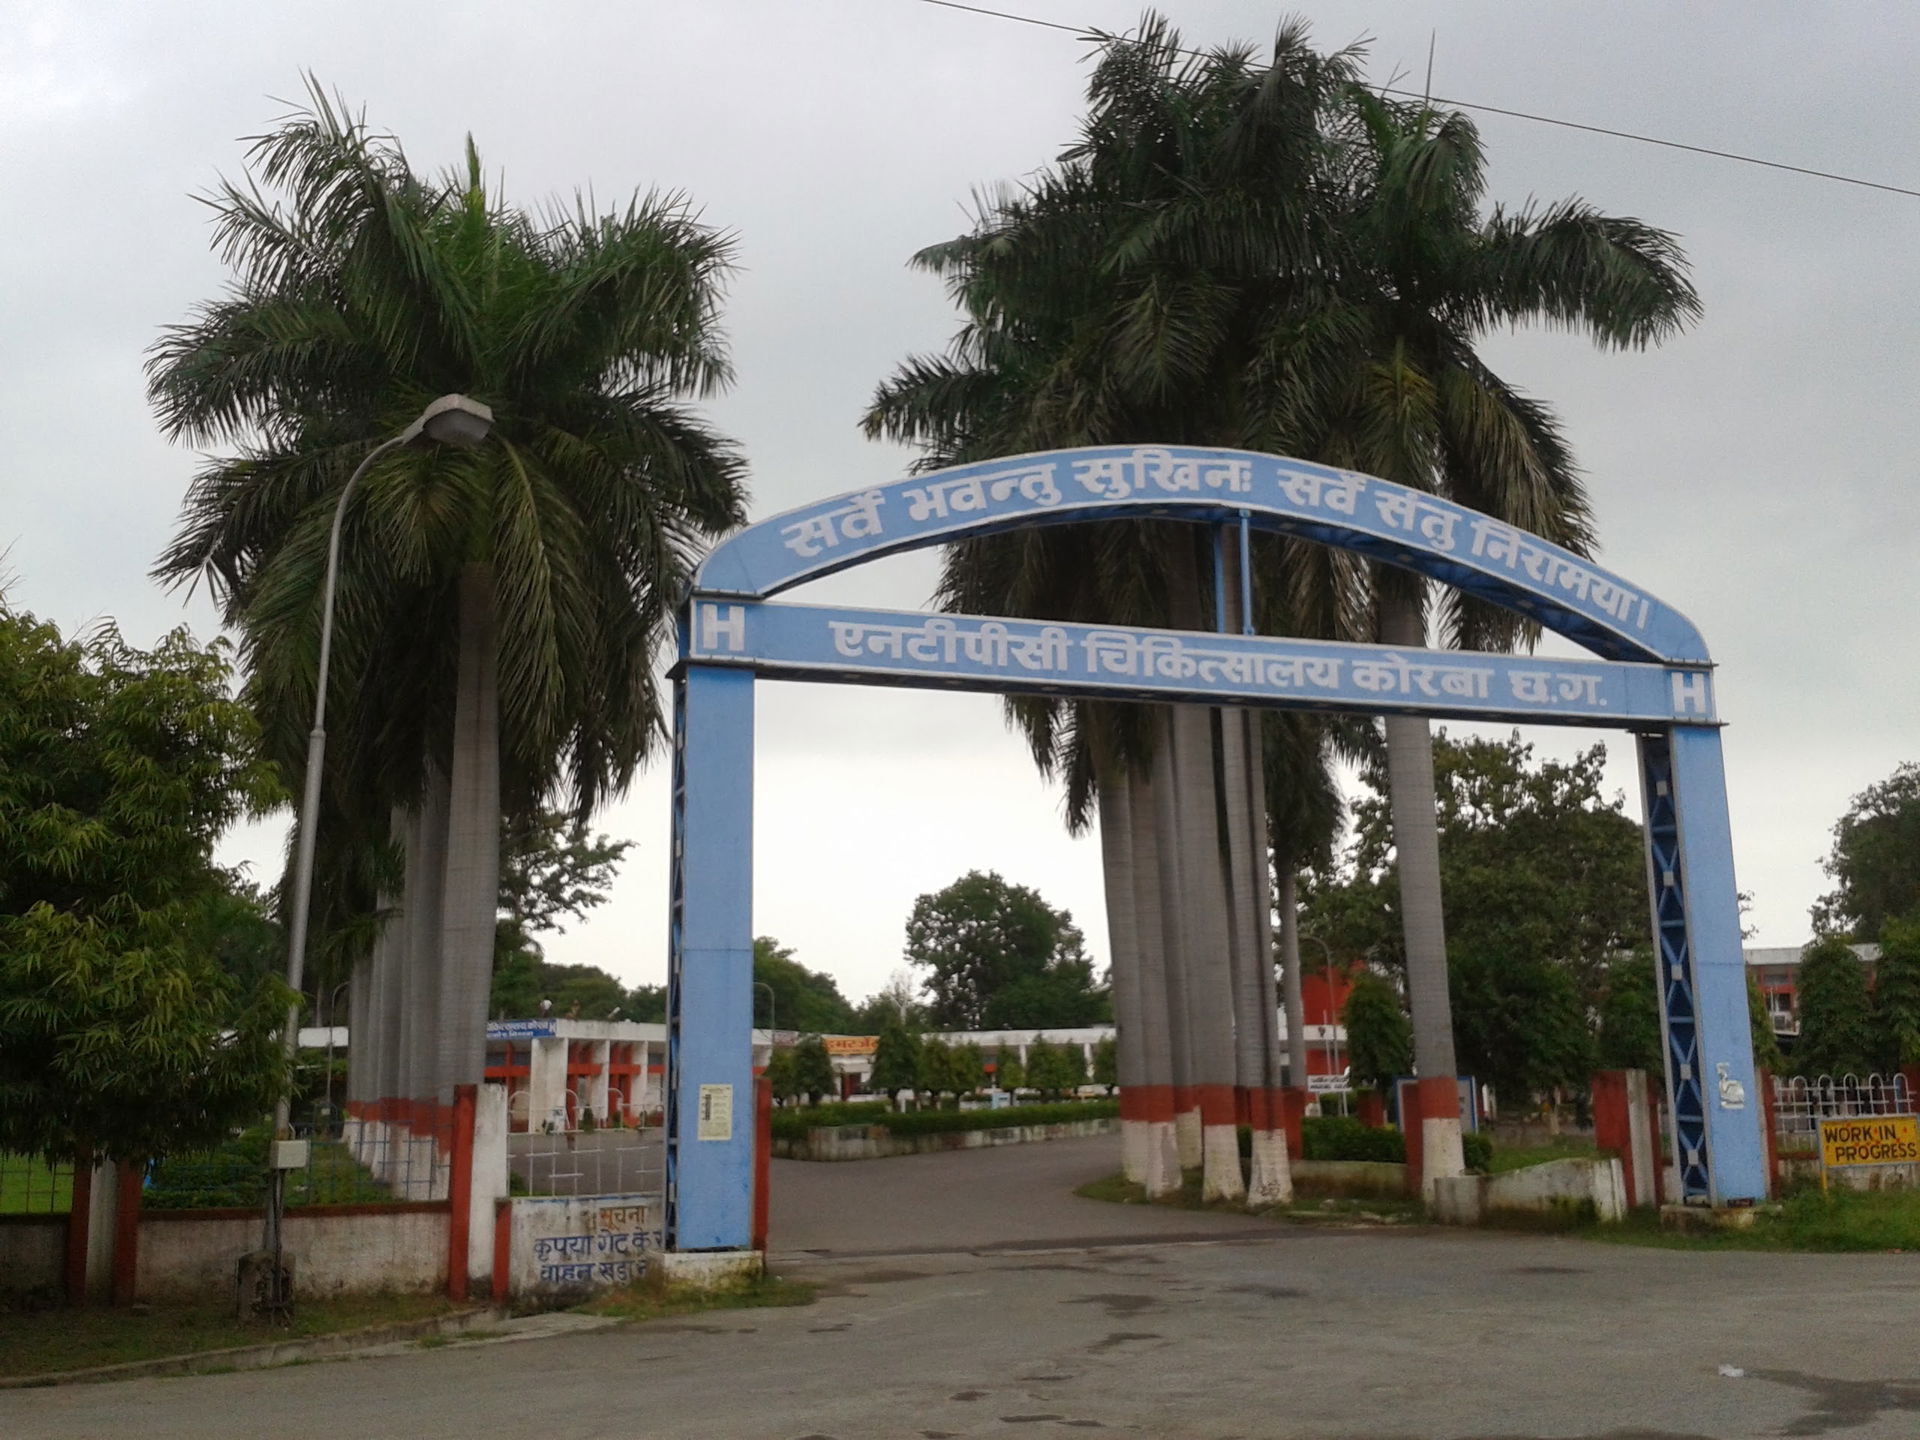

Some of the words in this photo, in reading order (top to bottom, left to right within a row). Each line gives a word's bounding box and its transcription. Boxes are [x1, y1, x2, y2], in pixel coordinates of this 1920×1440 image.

[903, 463, 1063, 522] भवन्तु
[1375, 491, 1462, 552] संतु
[702, 604, 745, 652] H
[829, 617, 1074, 672] एनटीपीसी
[1080, 630, 1345, 690] चिकित्सालय
[1352, 644, 1495, 700] कोरबा
[1671, 671, 1707, 714] H
[1824, 1126, 1874, 1144] WORK
[1878, 1124, 1897, 1141] IN
[1834, 1142, 1918, 1162] PROGRESS
[599, 1205, 648, 1231] सूचना
[533, 1234, 594, 1261] कृपया
[598, 1227, 629, 1254] गेट
[631, 1226, 651, 1253] के
[540, 1262, 595, 1284] वाहन
